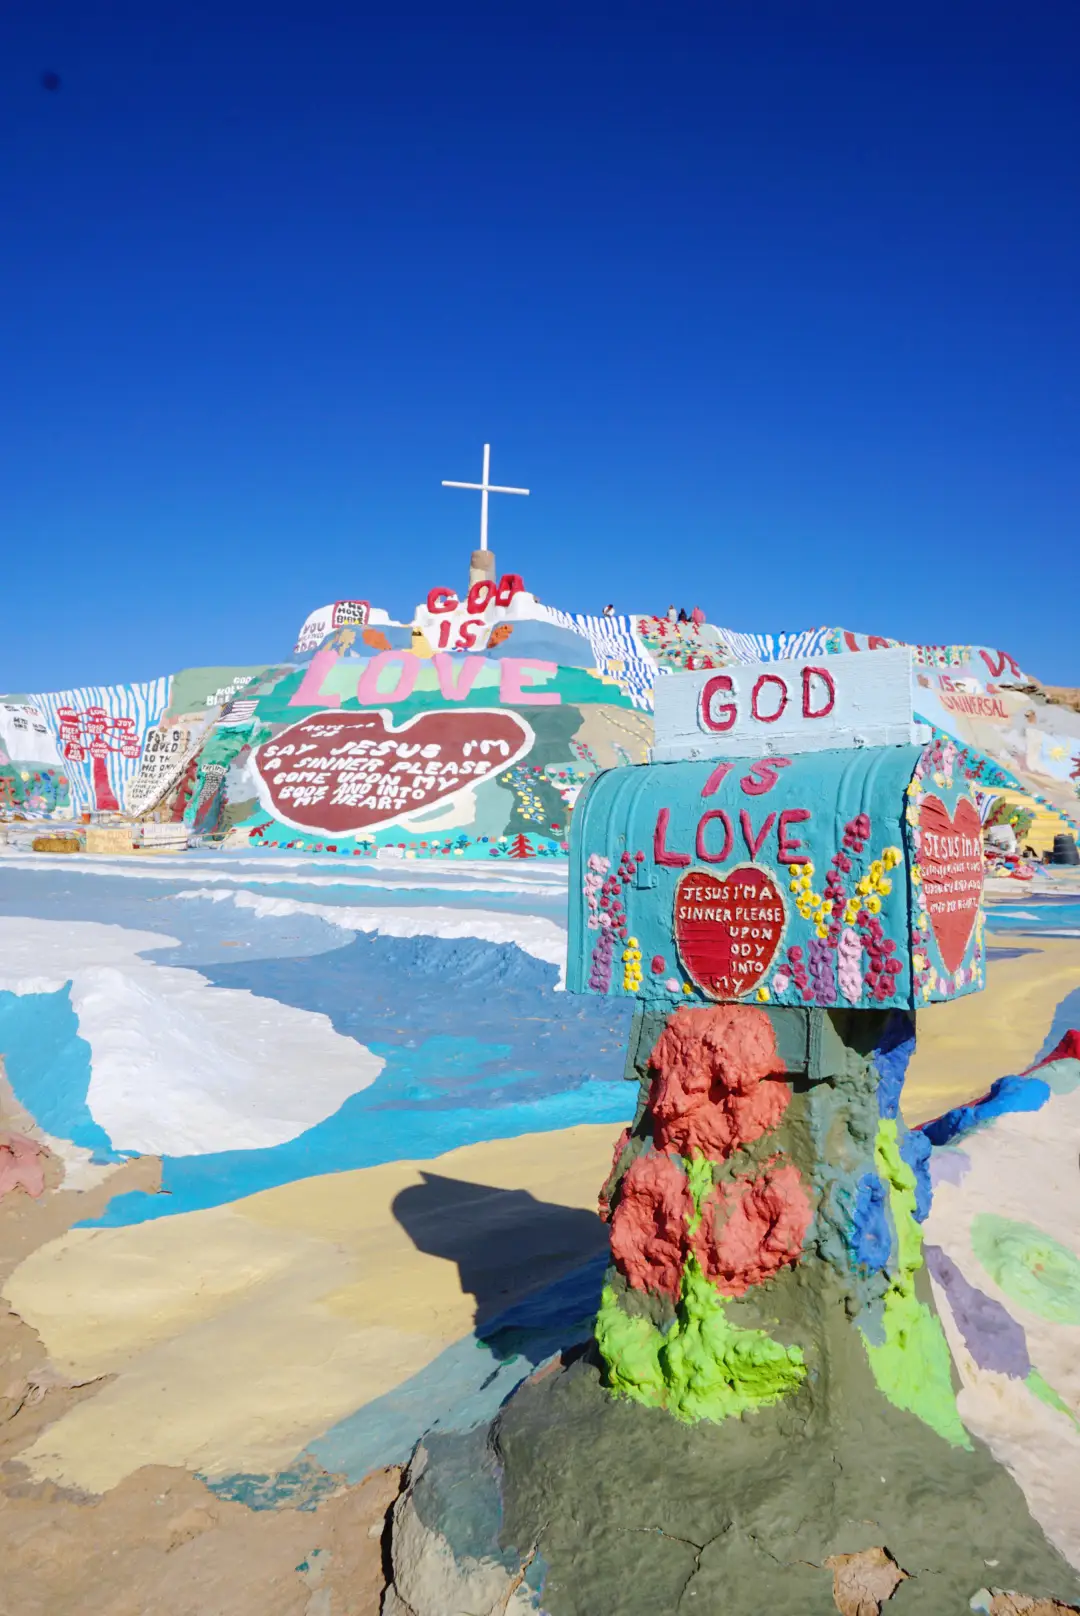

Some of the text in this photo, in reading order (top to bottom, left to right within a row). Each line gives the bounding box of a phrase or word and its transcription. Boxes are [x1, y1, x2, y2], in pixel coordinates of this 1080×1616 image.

[427, 573, 525, 614] GOD
[337, 608, 363, 617] HOLY
[438, 619, 486, 648] IS
[288, 650, 562, 708] LOVE
[938, 675, 955, 692] IS
[701, 666, 836, 731] GOD
[939, 695, 1008, 718] UNIVERSAL
[263, 740, 510, 758] SAY JESUS I'M
[263, 756, 492, 775] A SINNER PLEASE
[273, 771, 459, 792] COME UPON MY
[701, 757, 792, 797] IS
[332, 783, 372, 796] AND
[377, 784, 426, 800] INTO
[292, 794, 407, 810] MY HEART
[653, 808, 812, 867] LOVE
[924, 832, 959, 859] JESUS
[683, 884, 773, 901] JESUS I'M A
[679, 906, 781, 922] SINNER PLEASE
[730, 926, 773, 941] UPON
[732, 960, 764, 974] INTO
